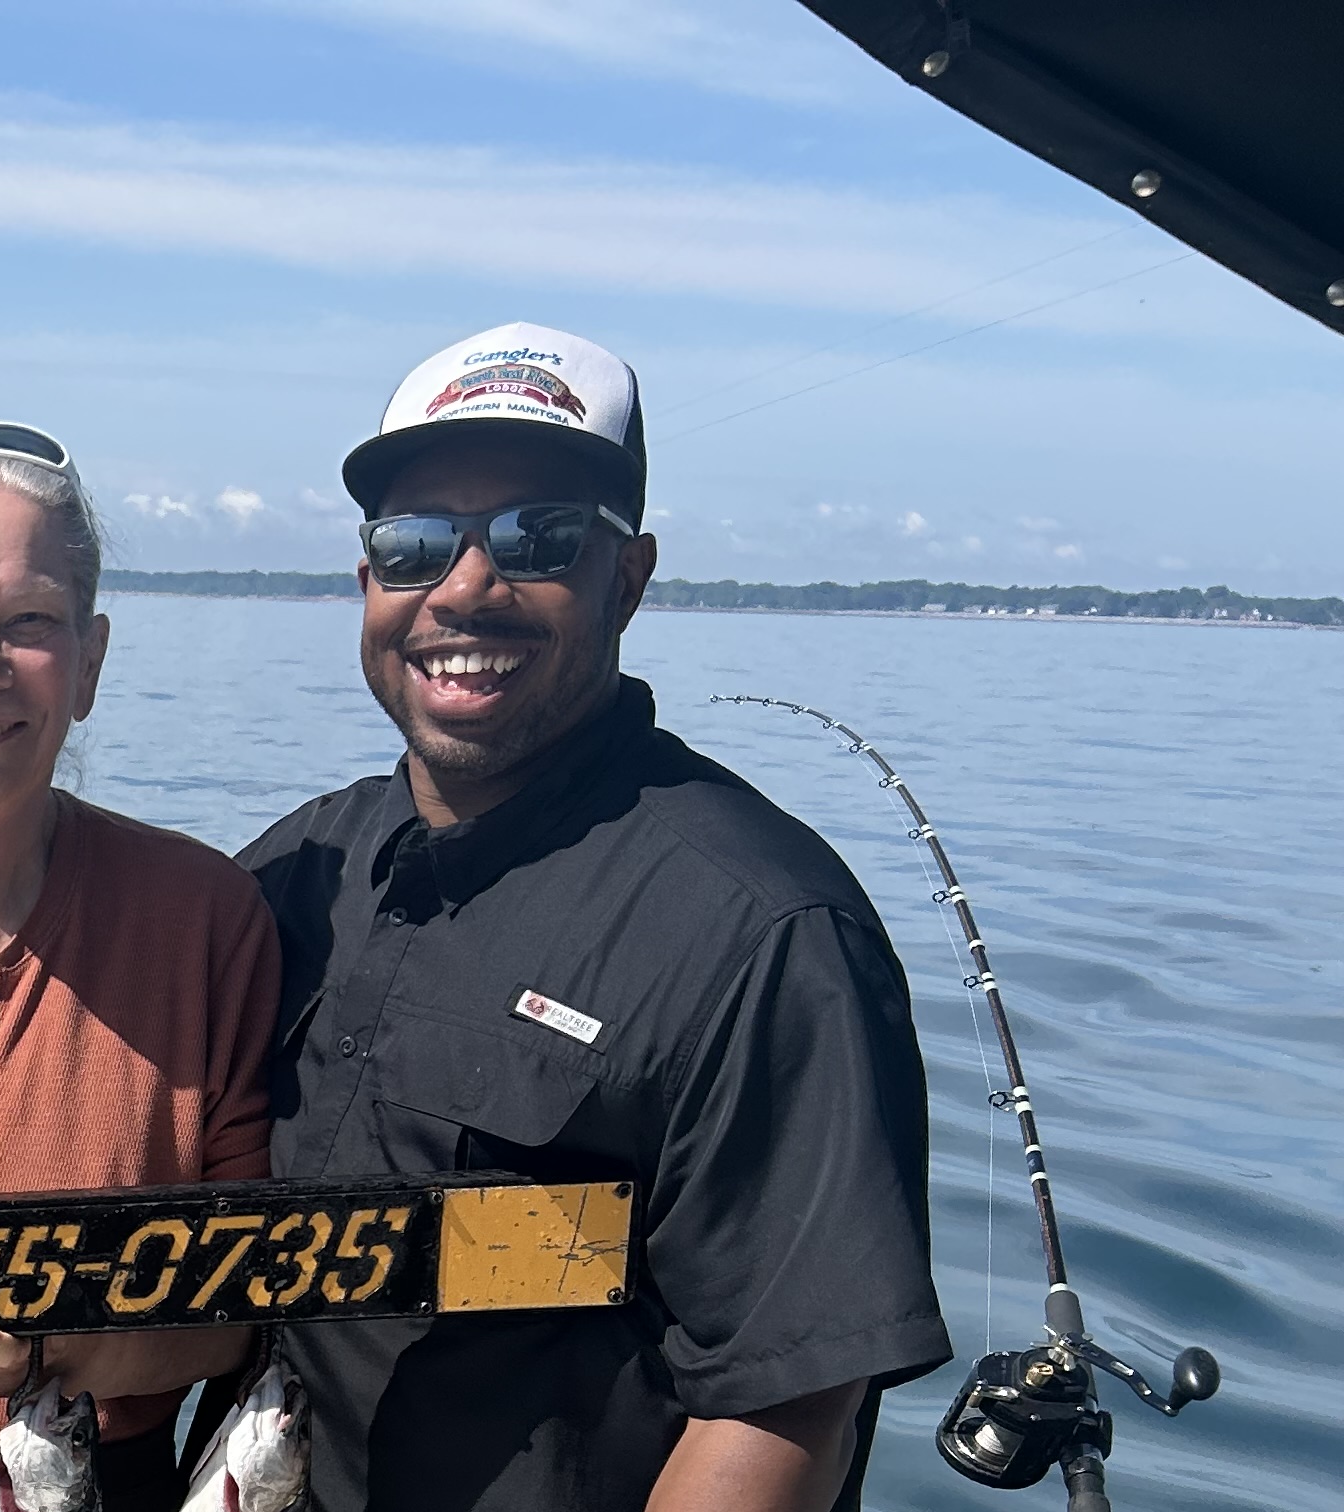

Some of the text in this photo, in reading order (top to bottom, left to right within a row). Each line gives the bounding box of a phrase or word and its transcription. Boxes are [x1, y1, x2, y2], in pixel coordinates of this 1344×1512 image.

[463, 348, 563, 367] Gangler's
[436, 402, 570, 426] NORTHERN MANITOBA
[546, 1006, 594, 1032] REALTREE
